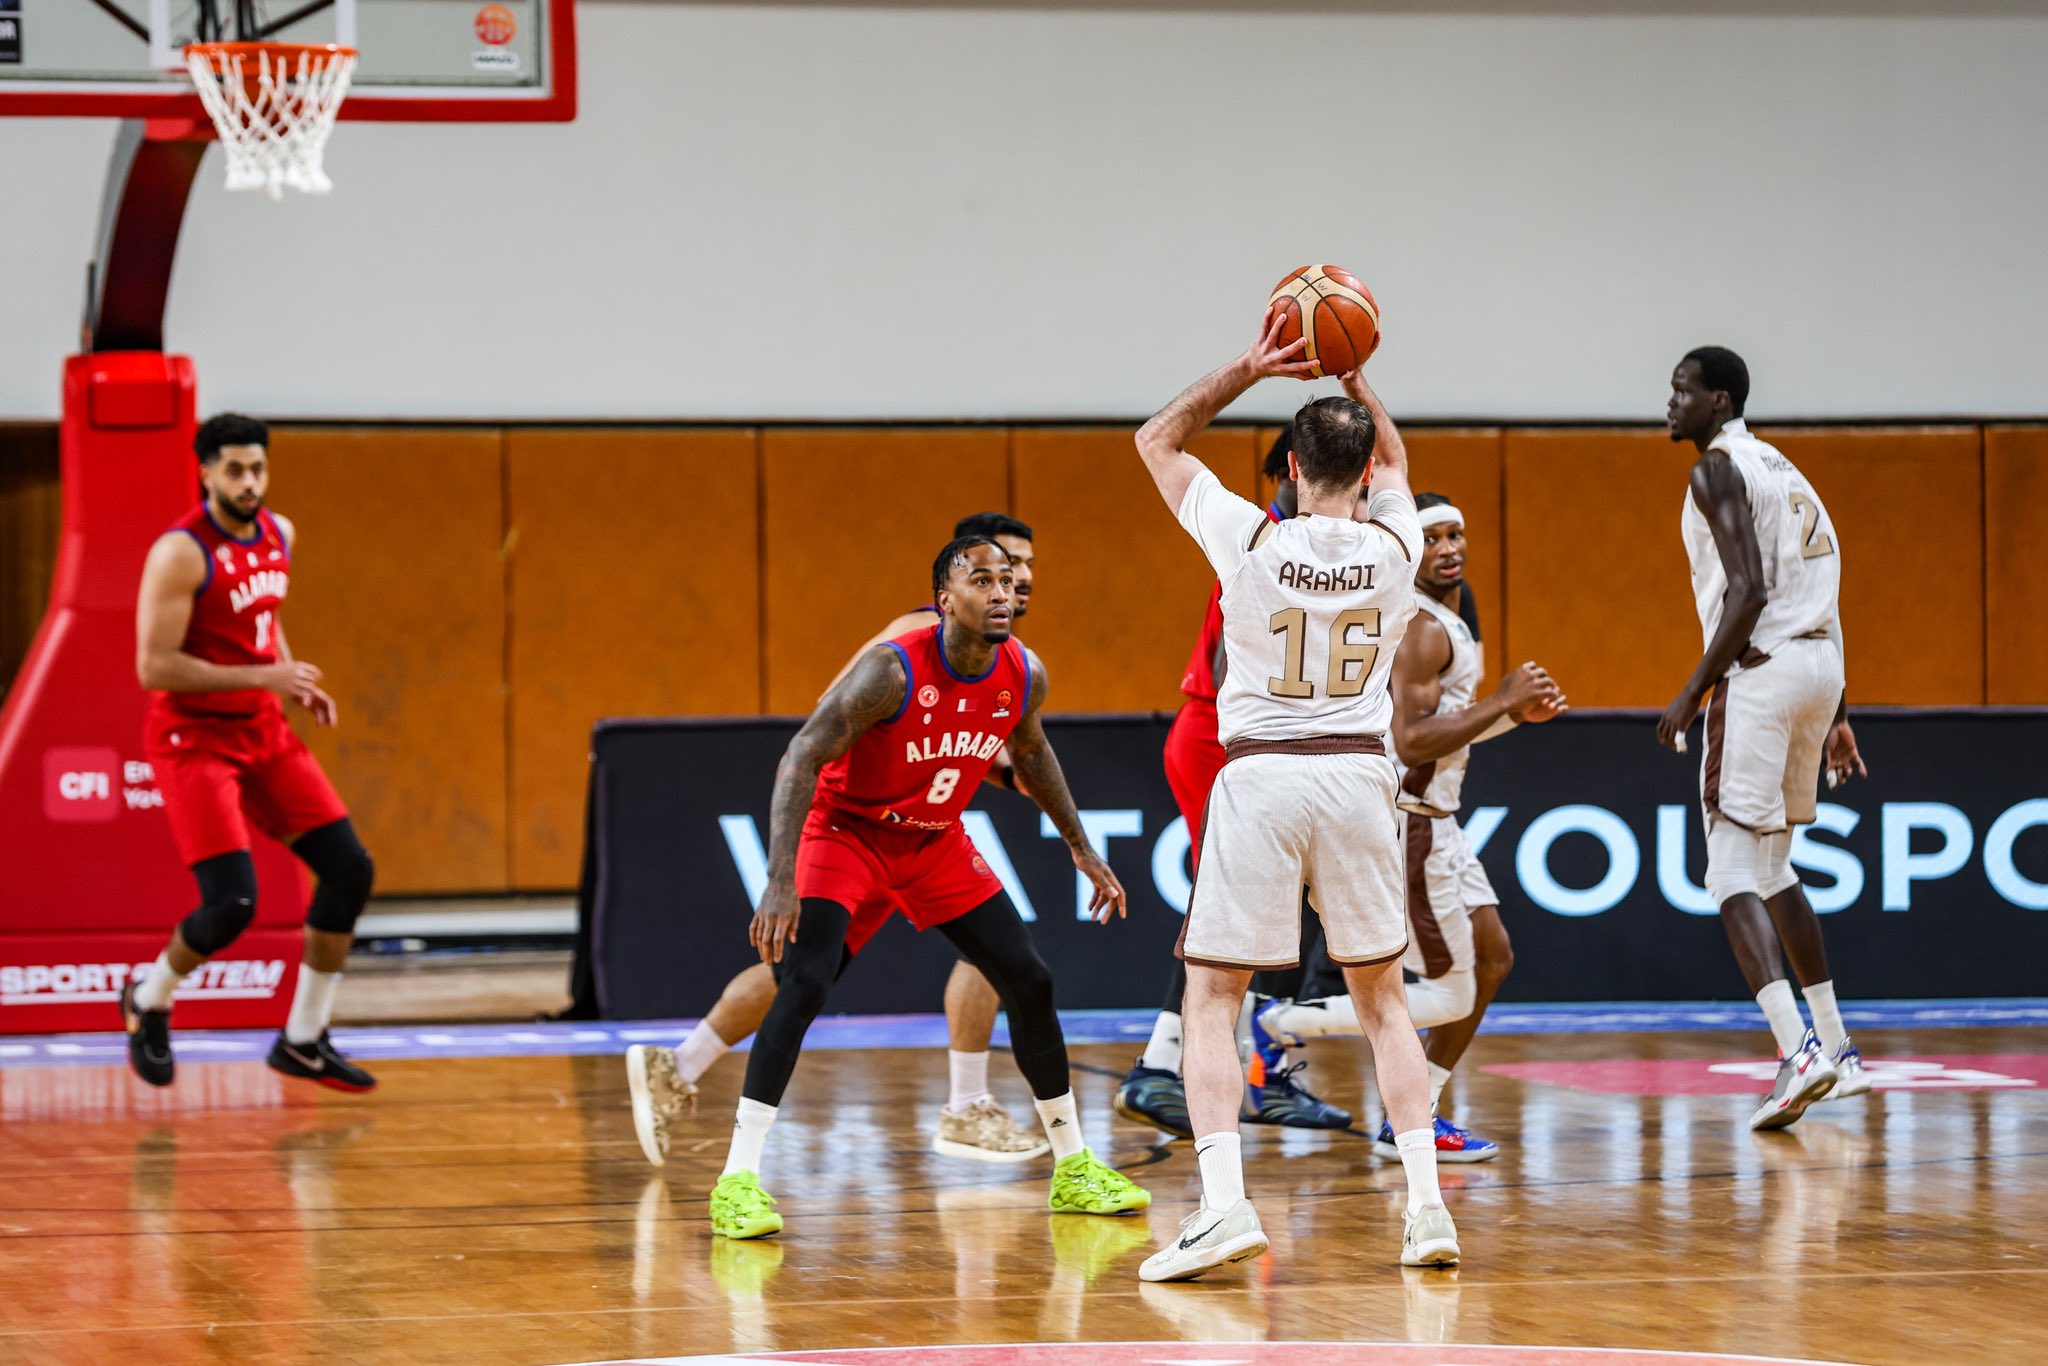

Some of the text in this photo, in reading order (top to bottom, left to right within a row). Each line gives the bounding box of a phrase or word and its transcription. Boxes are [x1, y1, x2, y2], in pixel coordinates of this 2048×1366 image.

[1789, 492, 1835, 560] 2
[1278, 561, 1375, 591] ARAKJI
[1267, 607, 1381, 699] 16
[906, 731, 1004, 763] ALARABI
[59, 771, 110, 800] CFI
[926, 768, 960, 804] 8
